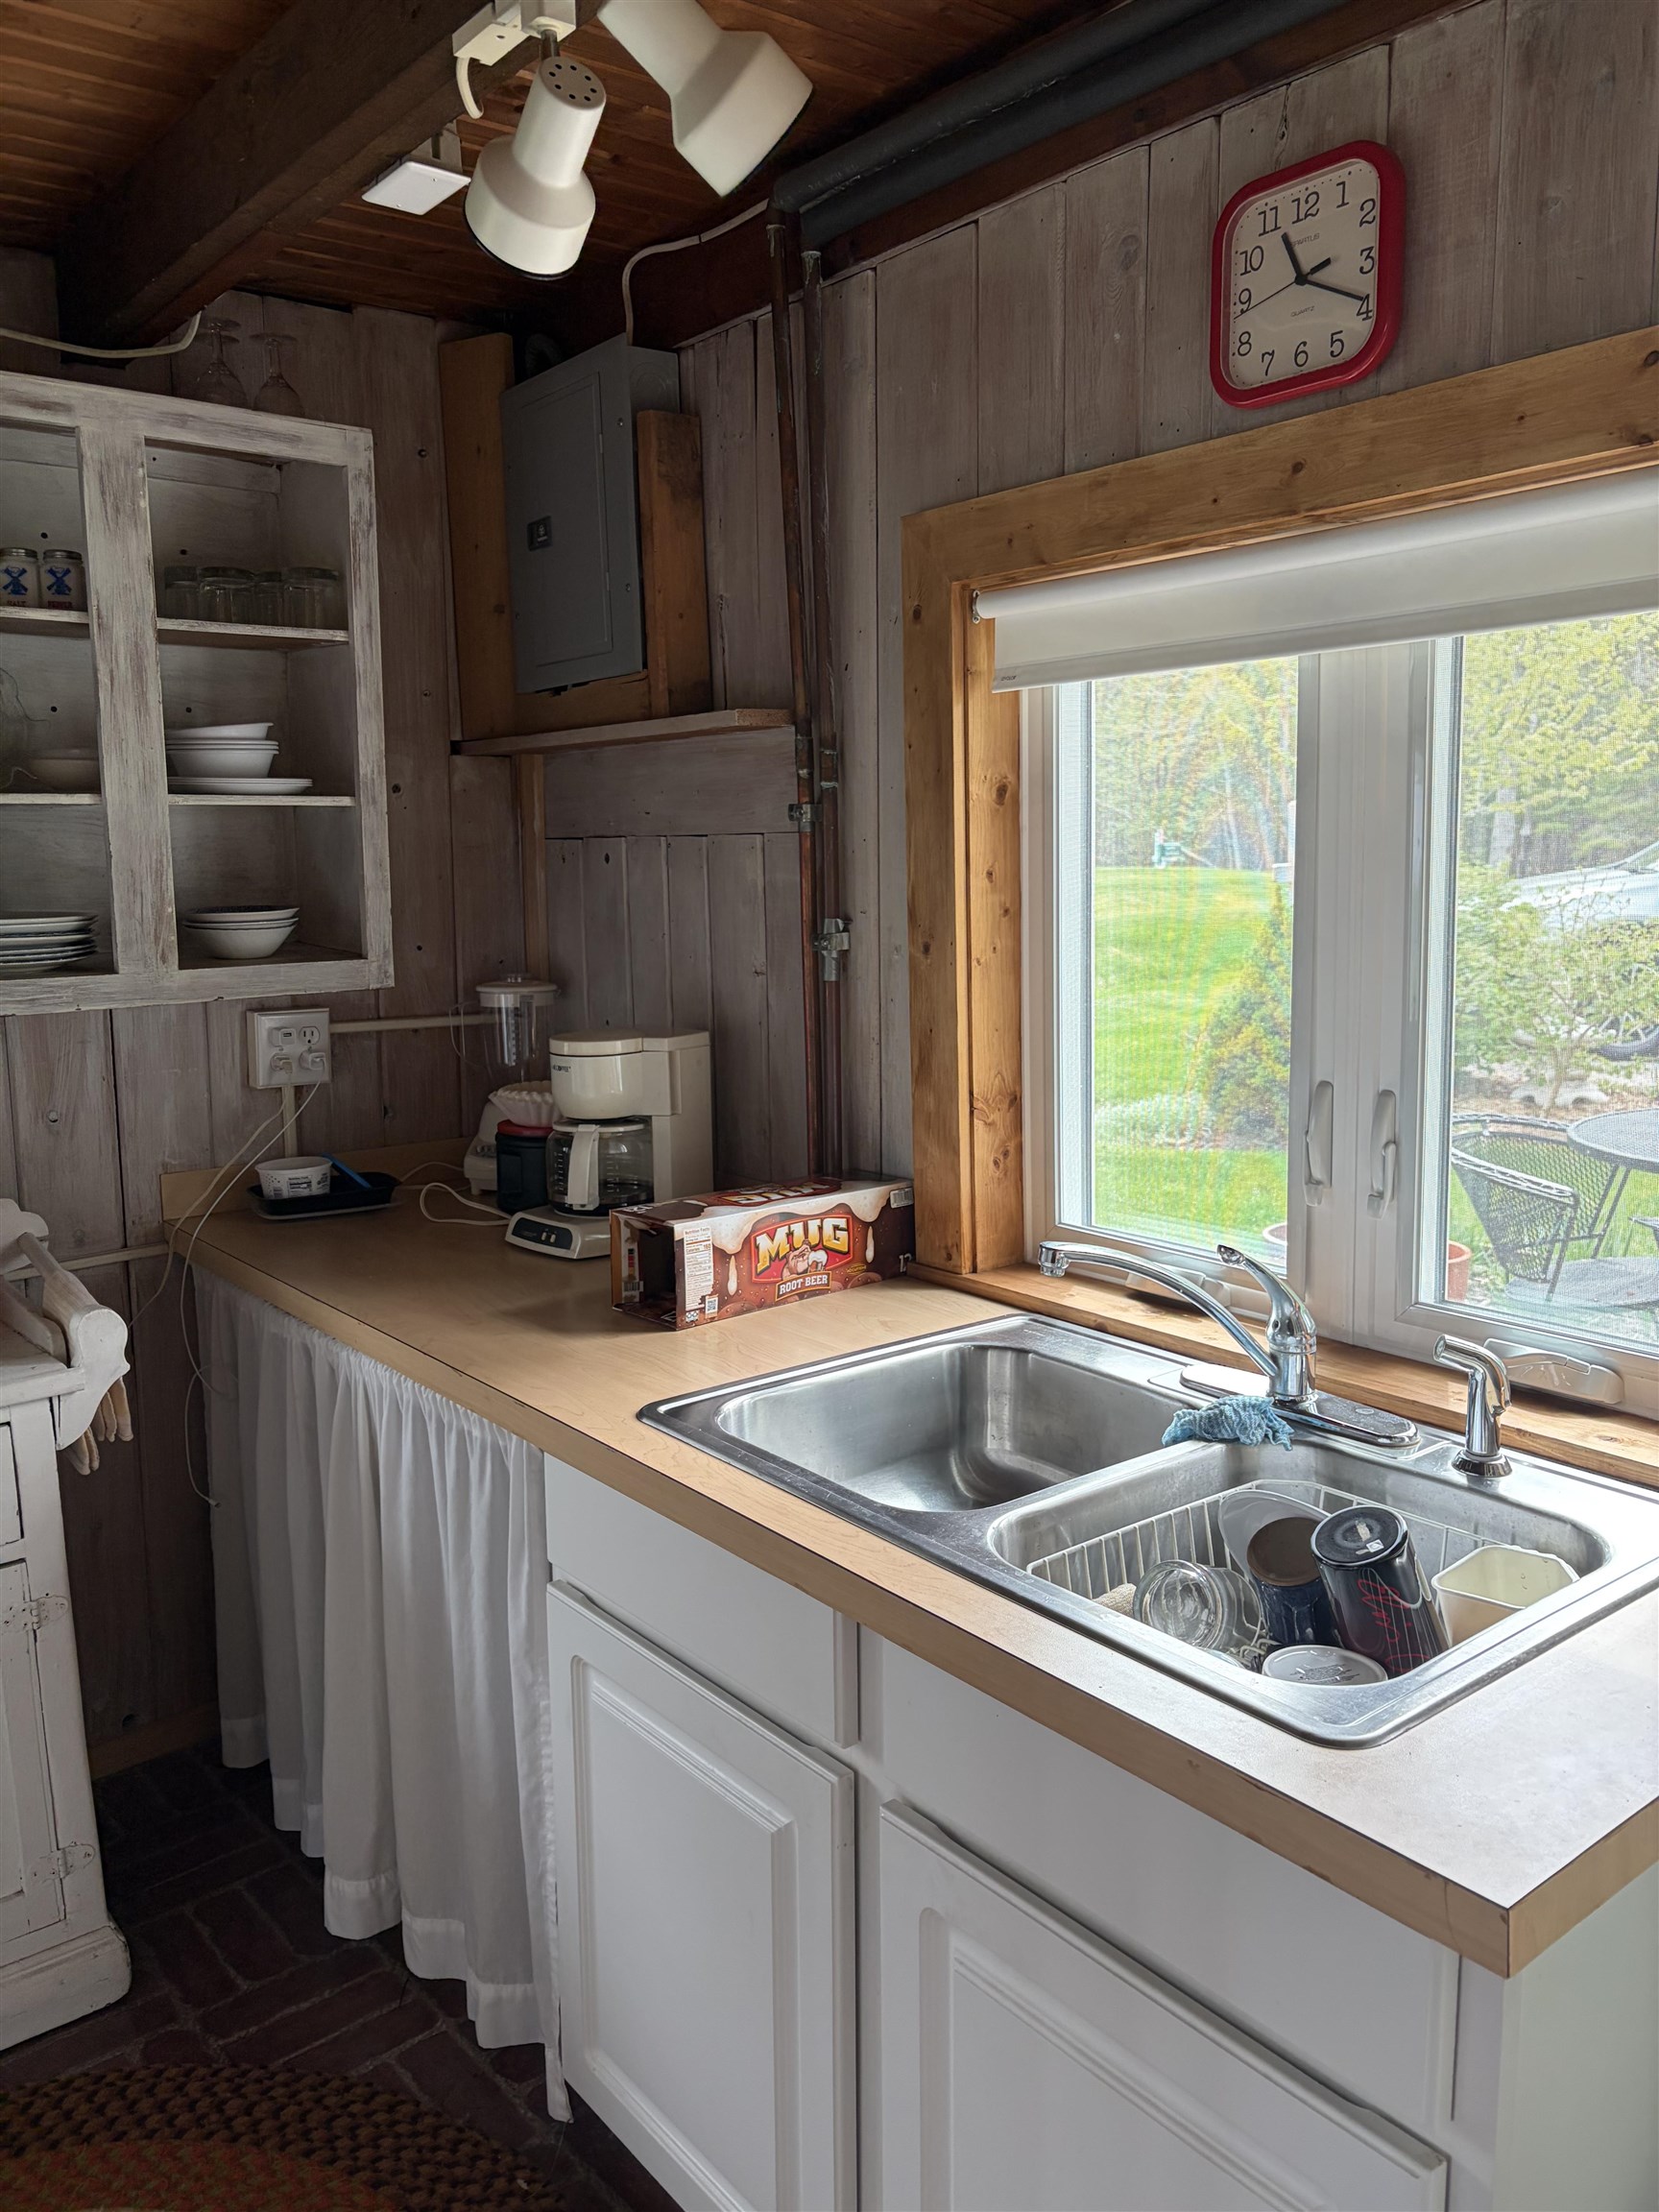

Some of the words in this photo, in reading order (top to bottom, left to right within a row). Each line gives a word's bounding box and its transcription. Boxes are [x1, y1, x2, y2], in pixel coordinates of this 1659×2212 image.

[1291, 190, 1320, 225] 12
[1335, 180, 1350, 208] 1
[1258, 205, 1282, 237] 11
[1358, 198, 1376, 228] 2
[1238, 245, 1264, 276] 10
[1358, 246, 1375, 275] 3
[1238, 288, 1252, 314] 9
[1356, 293, 1373, 322] 4
[1237, 330, 1252, 357] 8
[1294, 341, 1309, 368] 6
[1330, 330, 1344, 358] 5
[1261, 349, 1275, 376] 7
[756, 1217, 849, 1275] MUG
[779, 1279, 804, 1295] ROOT
[805, 1274, 828, 1286] BEER
